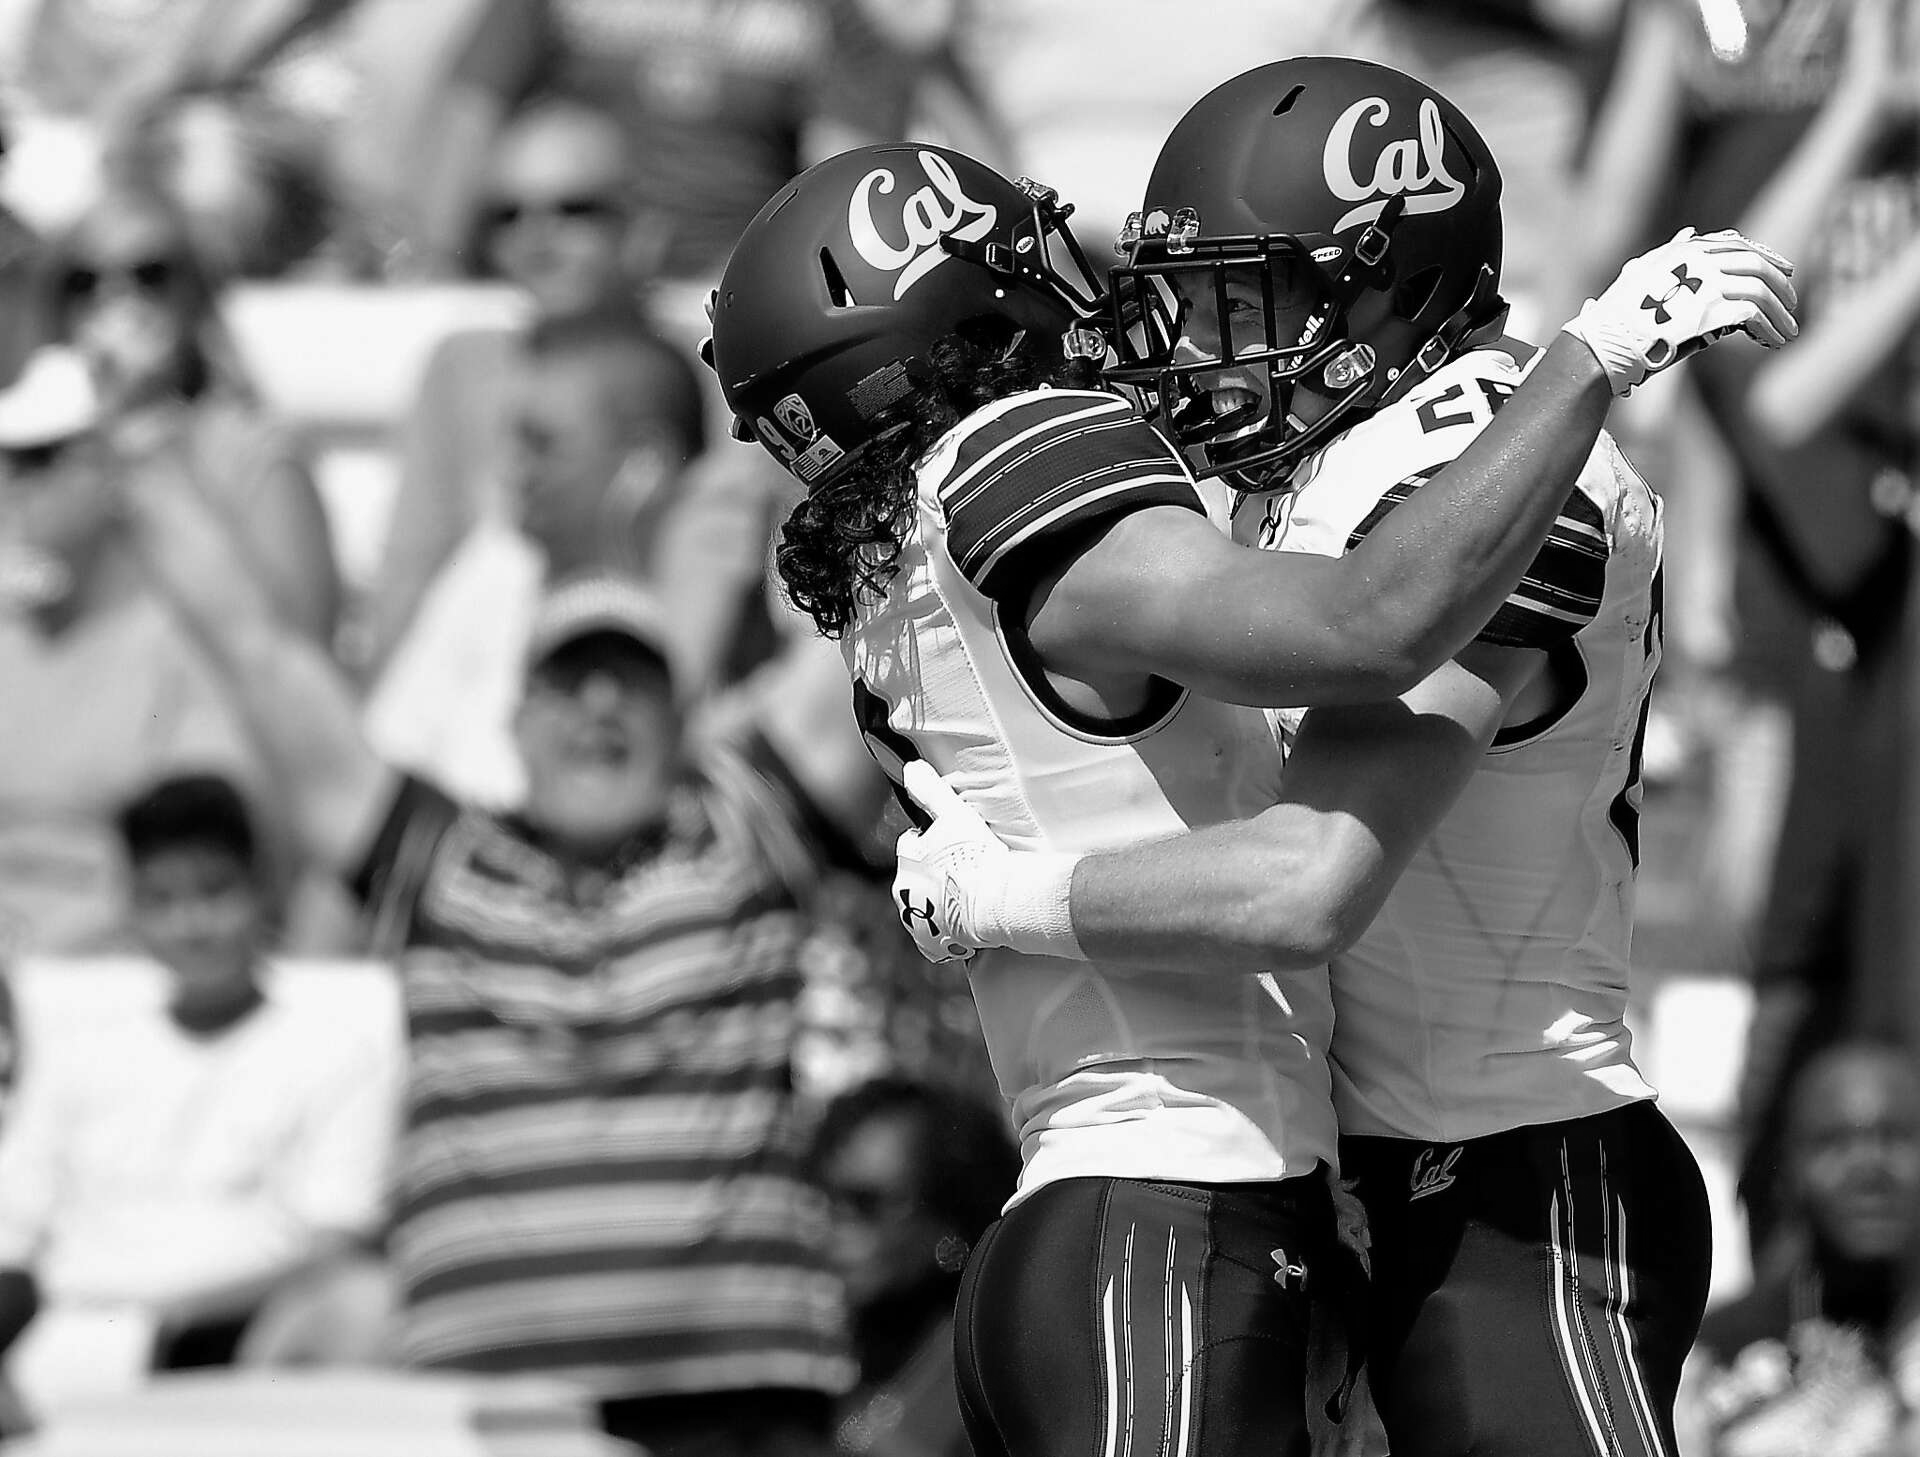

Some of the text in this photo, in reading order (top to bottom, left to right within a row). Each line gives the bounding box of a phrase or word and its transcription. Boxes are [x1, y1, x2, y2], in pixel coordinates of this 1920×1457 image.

[1323, 97, 1465, 234] Cal
[848, 150, 997, 300] Cal
[756, 416, 798, 461] 9
[1409, 1146, 1464, 1201] Cal
